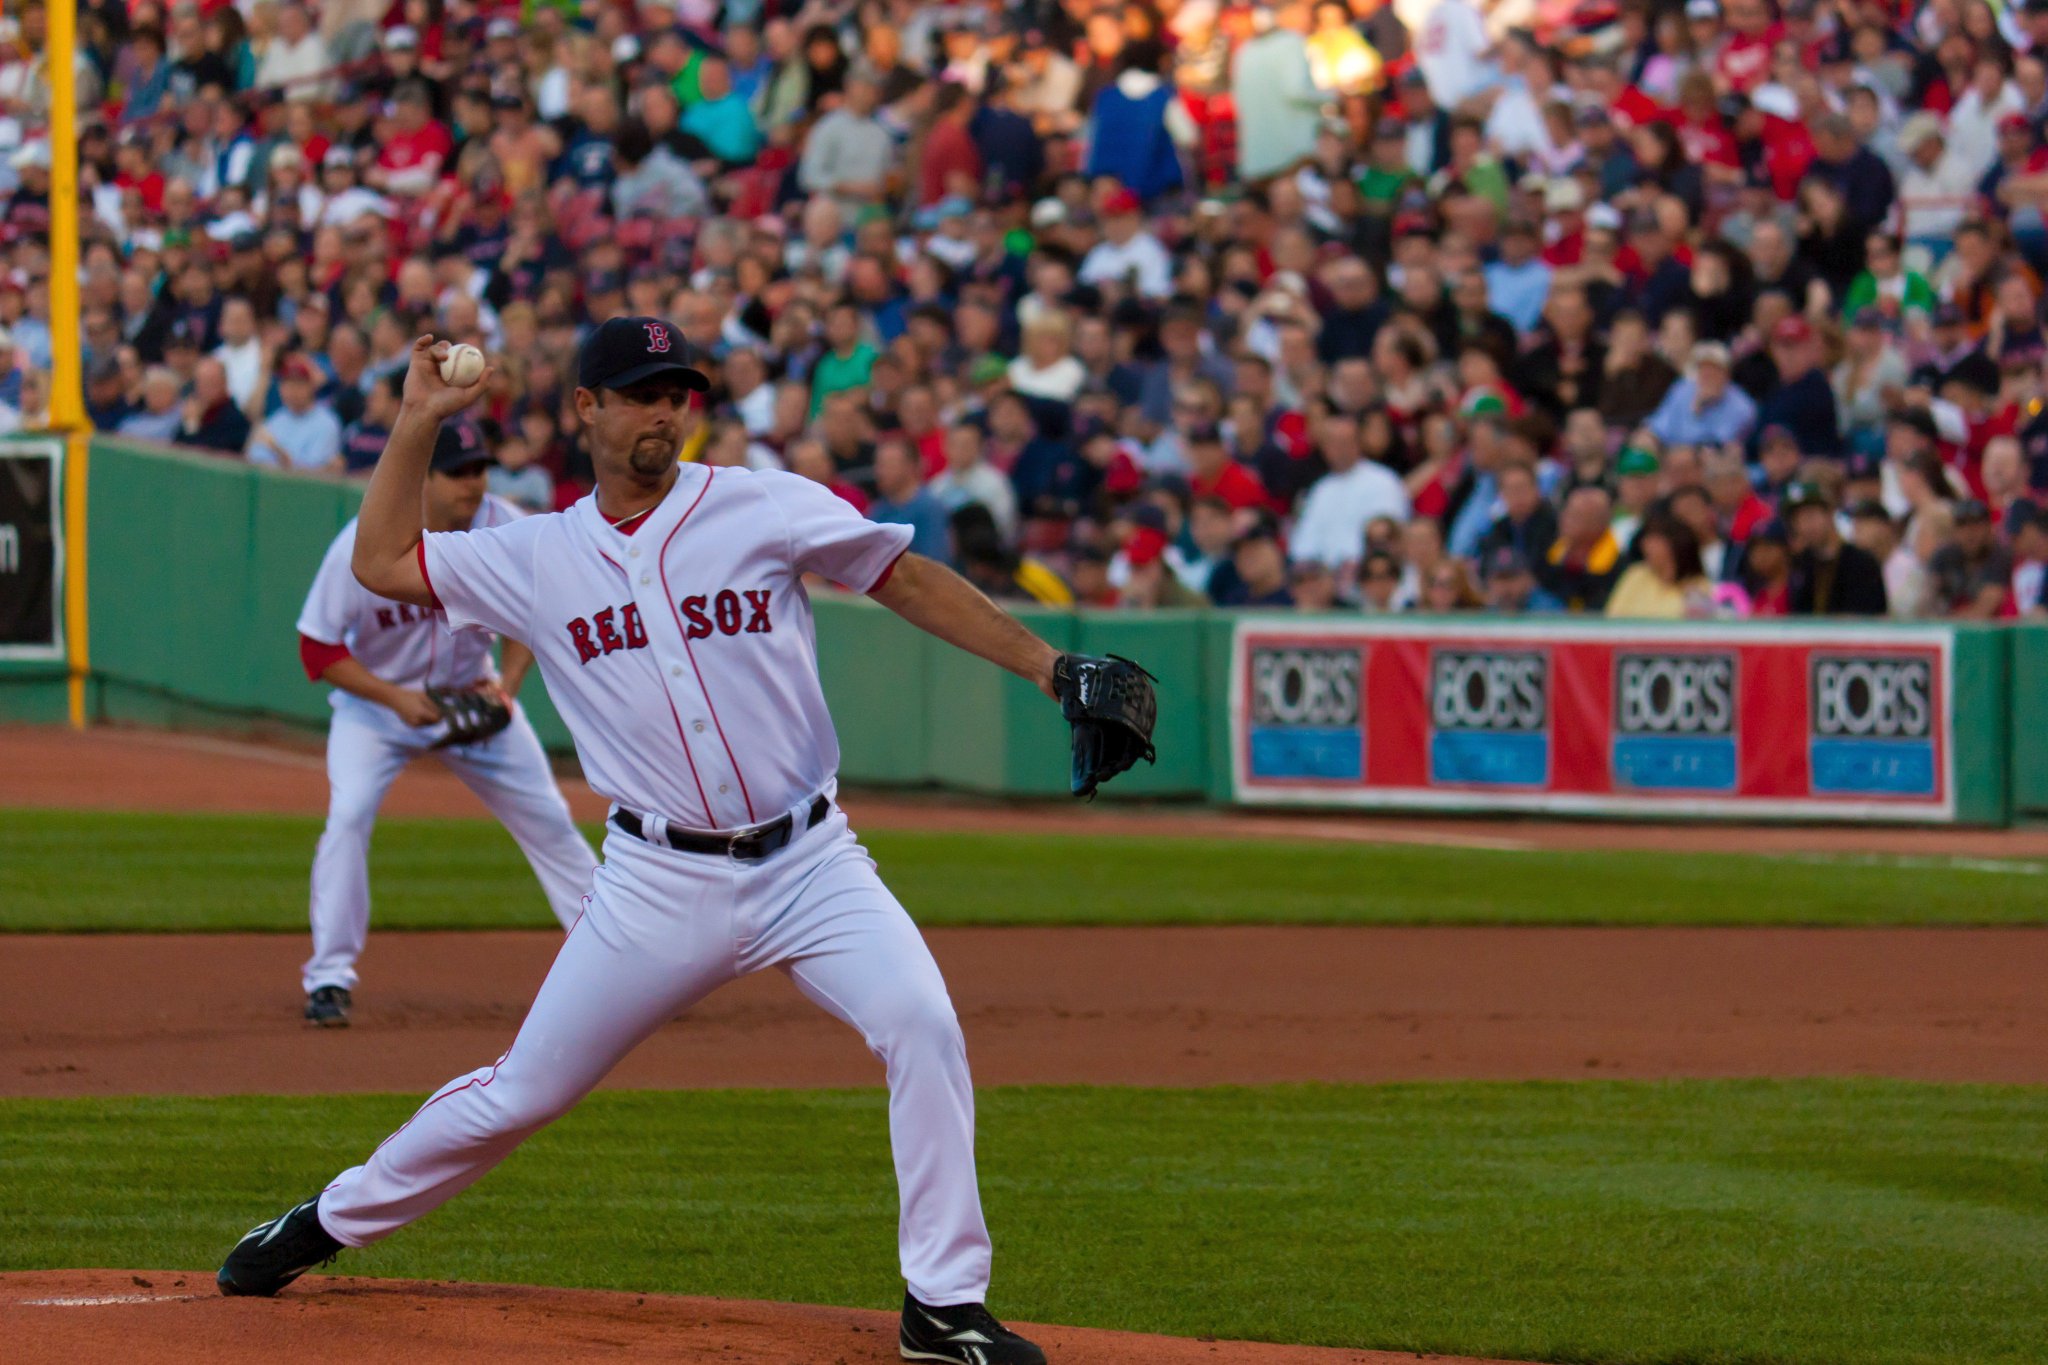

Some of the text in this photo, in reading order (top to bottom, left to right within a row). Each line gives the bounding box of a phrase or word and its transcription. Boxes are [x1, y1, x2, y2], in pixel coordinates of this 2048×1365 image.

[643, 323, 671, 352] B
[566, 589, 773, 665] RED SOX
